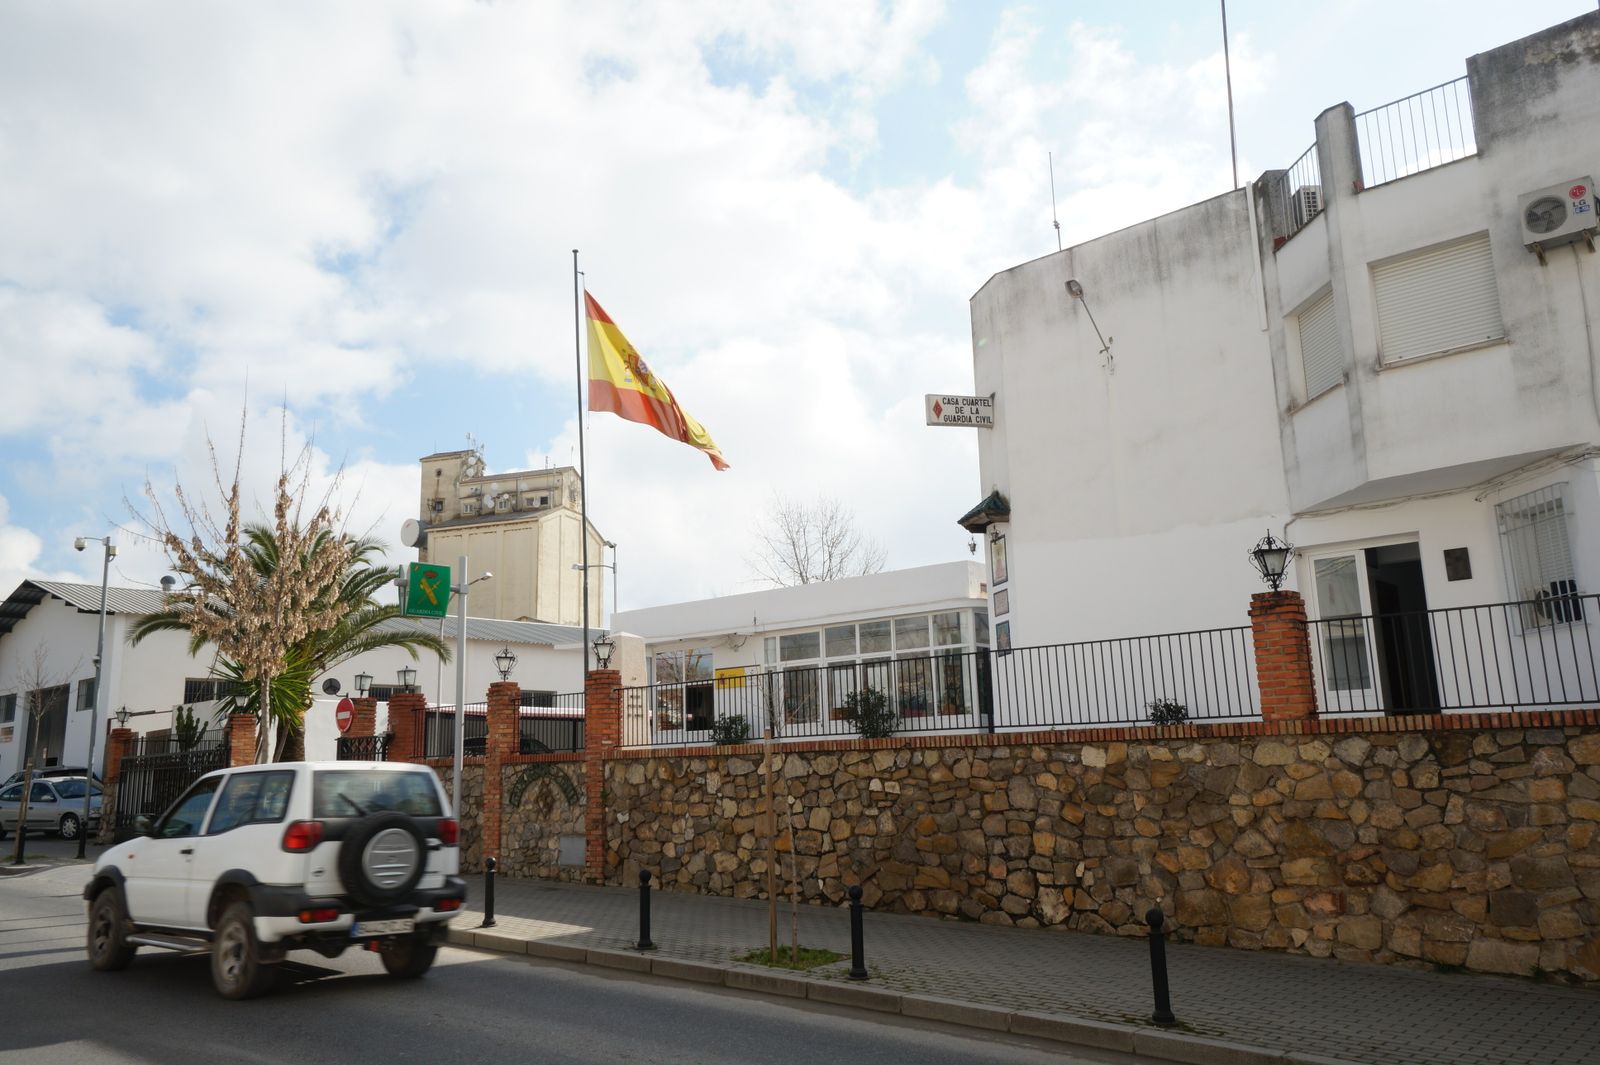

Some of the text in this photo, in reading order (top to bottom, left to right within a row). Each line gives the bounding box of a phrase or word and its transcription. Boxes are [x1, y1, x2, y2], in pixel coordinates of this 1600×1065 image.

[1572, 199, 1586, 207] LG
[942, 397, 992, 407] CASA CUARTEL
[955, 406, 980, 415] DE LA
[943, 415, 992, 424] GUARDIA CIVIL
